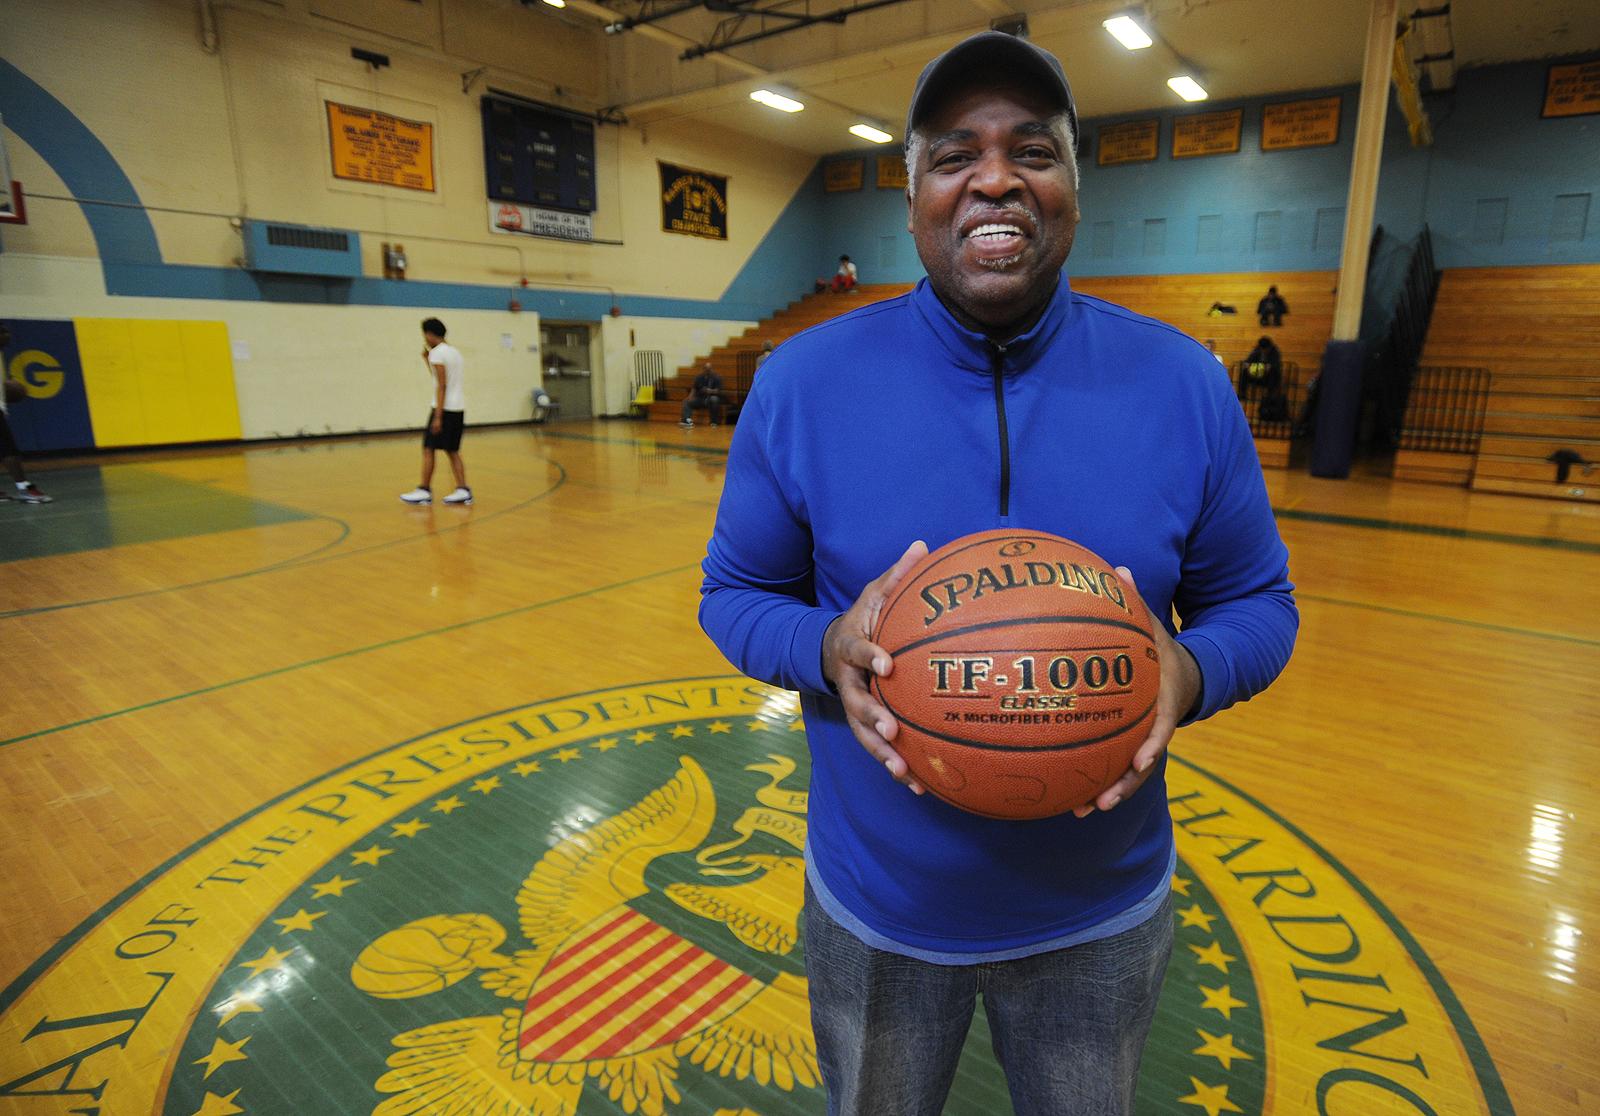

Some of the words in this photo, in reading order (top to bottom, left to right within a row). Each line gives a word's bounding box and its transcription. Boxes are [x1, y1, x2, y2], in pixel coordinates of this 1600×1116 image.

[533, 222, 591, 240] PRESIDENTS
[920, 562, 1130, 628] SPALDING
[928, 653, 1134, 693] TF-1000
[964, 712, 1050, 725] MICROFIBER
[1055, 708, 1123, 724] COMPOSITE
[1000, 695, 1077, 711] CLASSIC
[0, 971, 175, 1116] AL
[114, 902, 200, 960] OF
[195, 824, 313, 890] THE
